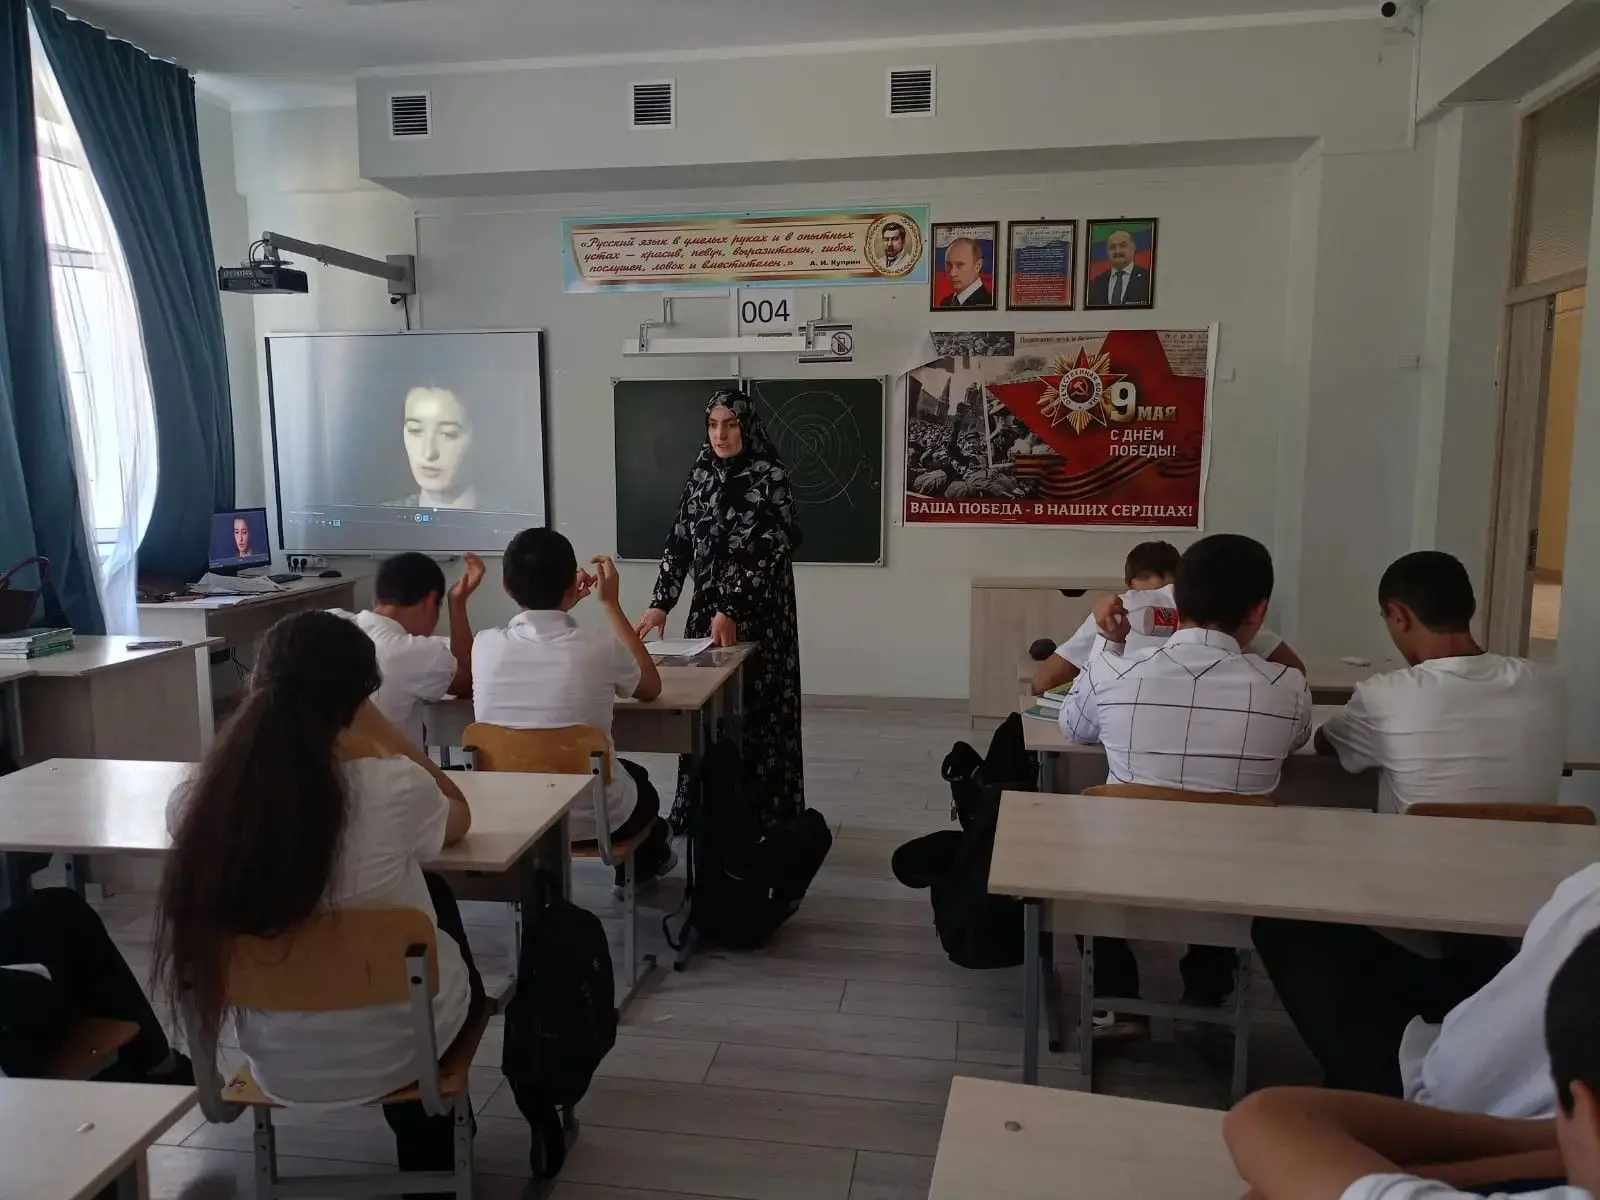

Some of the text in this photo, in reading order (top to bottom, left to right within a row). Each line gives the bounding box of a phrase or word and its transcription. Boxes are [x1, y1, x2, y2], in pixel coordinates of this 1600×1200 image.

[581, 238, 635, 250] «Русский
[638, 239, 668, 247] язык
[673, 236, 681, 245] в
[684, 237, 728, 248] умелых
[731, 235, 768, 246] руках
[785, 232, 793, 241] в
[797, 231, 854, 241] опытных
[584, 251, 620, 263] устах
[641, 248, 684, 261] красив,
[733, 246, 814, 259] выразителен,
[821, 242, 857, 253] гибок,
[589, 264, 646, 275] послушен,
[652, 261, 684, 271] ловок
[742, 299, 790, 323] 004
[1110, 381, 1177, 422] 9 МАЯ
[1110, 426, 1164, 442] С ДНЁМ
[1109, 444, 1177, 458] ПОБЕДЫ!
[910, 501, 956, 514] ВАША
[959, 502, 1022, 515] ПОБЕДА
[1034, 503, 1043, 515] В
[1047, 504, 1108, 516] НАШИХ
[1111, 504, 1193, 517] СЕРДЦАХ!
